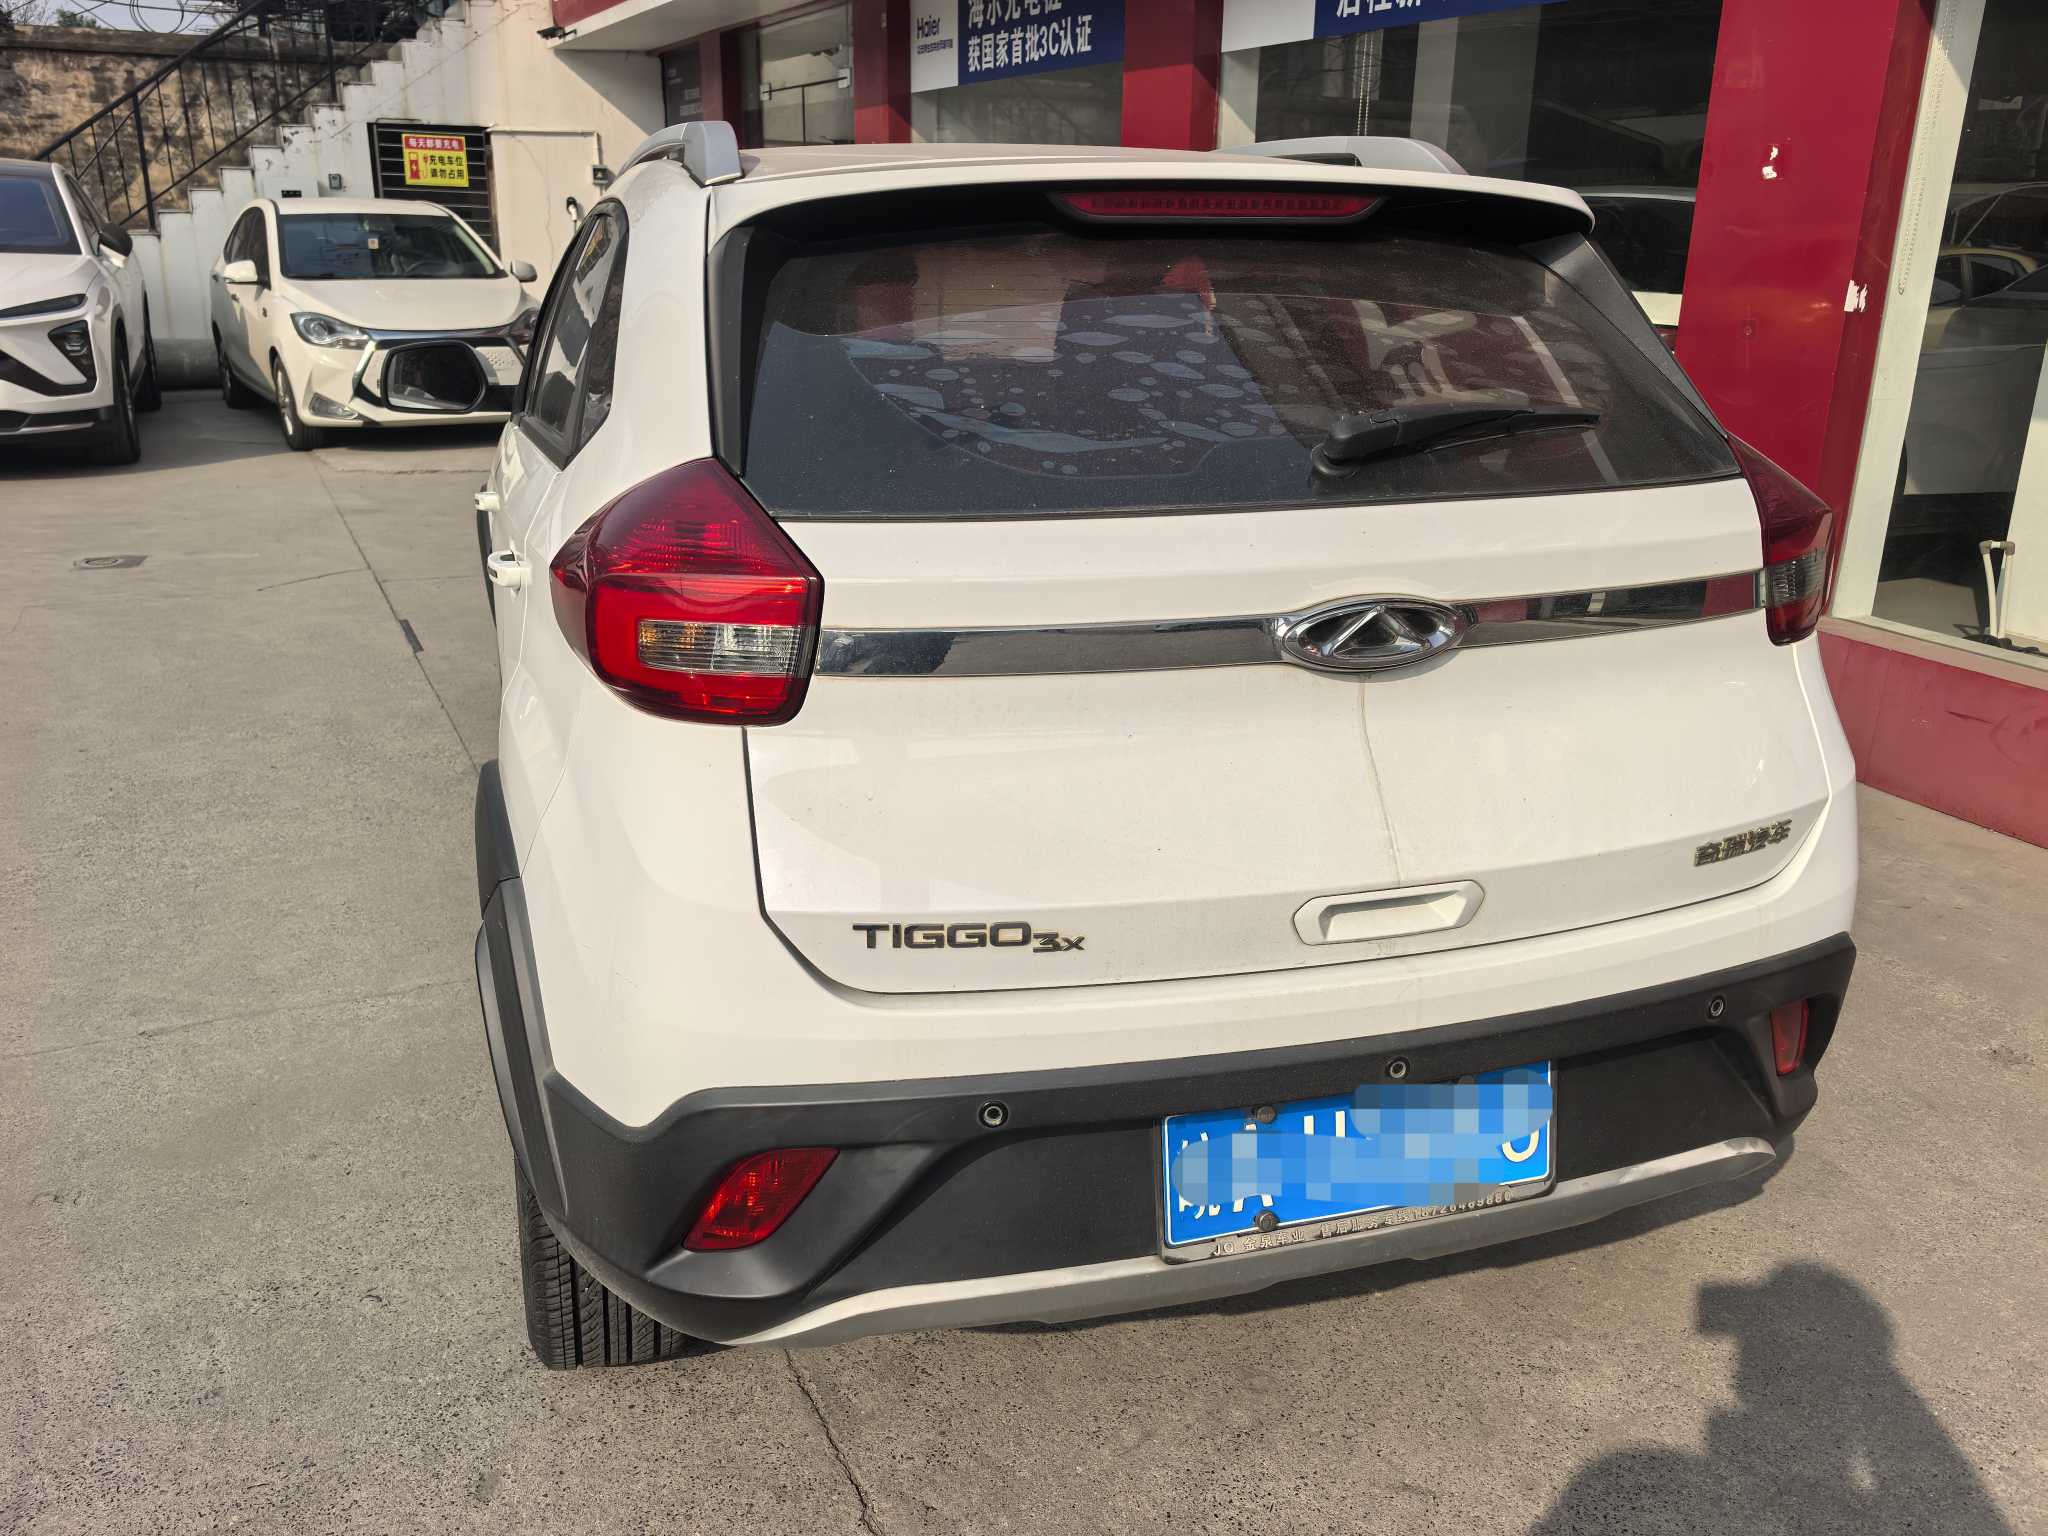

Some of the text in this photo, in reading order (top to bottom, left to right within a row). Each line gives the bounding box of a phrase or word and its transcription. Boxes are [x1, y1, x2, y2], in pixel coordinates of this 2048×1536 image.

[917, 15, 940, 39] Haier
[968, 15, 1092, 72] 获国家首批3C认证
[430, 155, 464, 167] 充电车位
[431, 168, 465, 180] 请勿占用
[1694, 819, 1792, 867] 奇瑞汽车
[853, 921, 1032, 949] TIGGO
